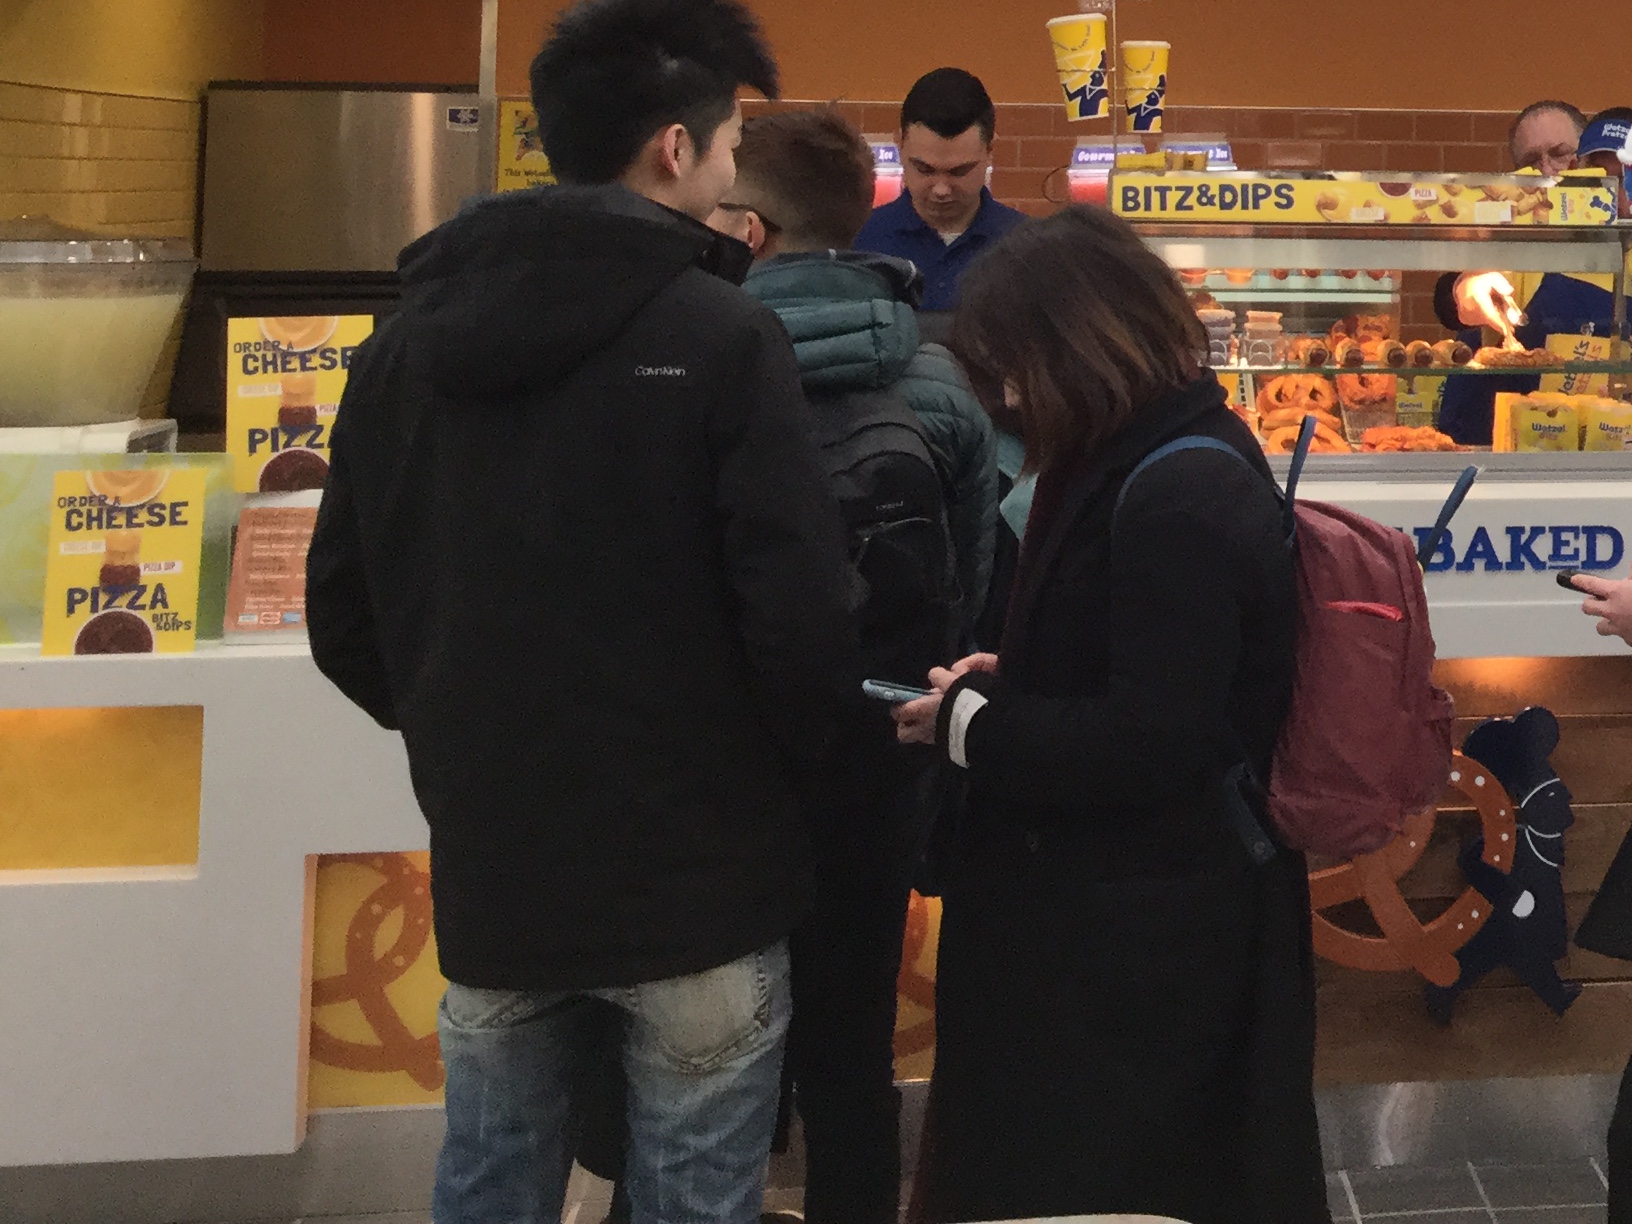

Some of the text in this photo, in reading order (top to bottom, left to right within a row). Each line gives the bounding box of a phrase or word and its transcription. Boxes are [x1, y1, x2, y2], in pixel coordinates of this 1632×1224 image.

[1414, 188, 1432, 198] PIZZA
[233, 338, 295, 354] ORDER A
[247, 424, 332, 458] PIZZ
[57, 494, 122, 509] ORDER A
[65, 501, 189, 532] CHEESE
[1413, 525, 1625, 572] BAKED
[66, 582, 170, 618] PIZZA
[151, 612, 179, 624] BITZ
[155, 620, 192, 632] &DIPS
